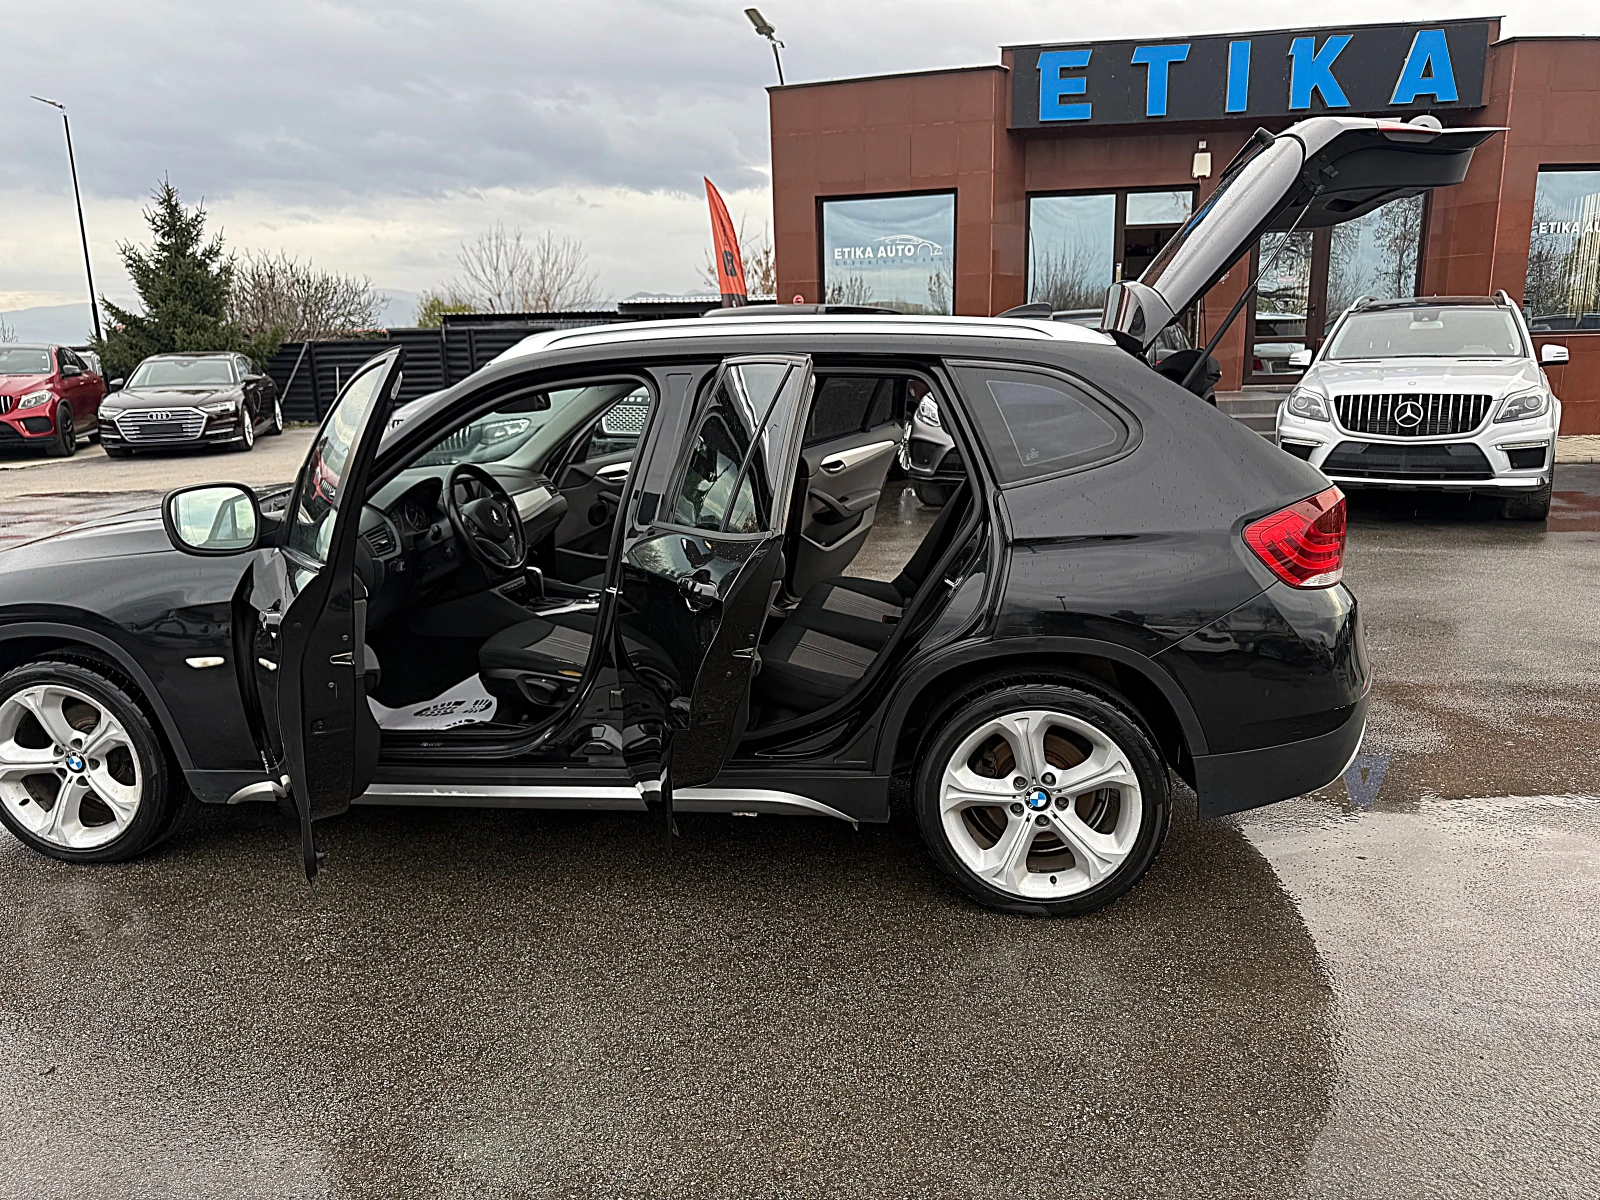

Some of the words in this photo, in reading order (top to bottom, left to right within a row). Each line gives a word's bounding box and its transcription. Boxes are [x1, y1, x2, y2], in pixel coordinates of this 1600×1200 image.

[1036, 28, 1459, 122] ETIKA
[1538, 221, 1580, 234] ETIKA
[834, 246, 874, 260] ETIKA
[877, 244, 915, 258] AUTO
